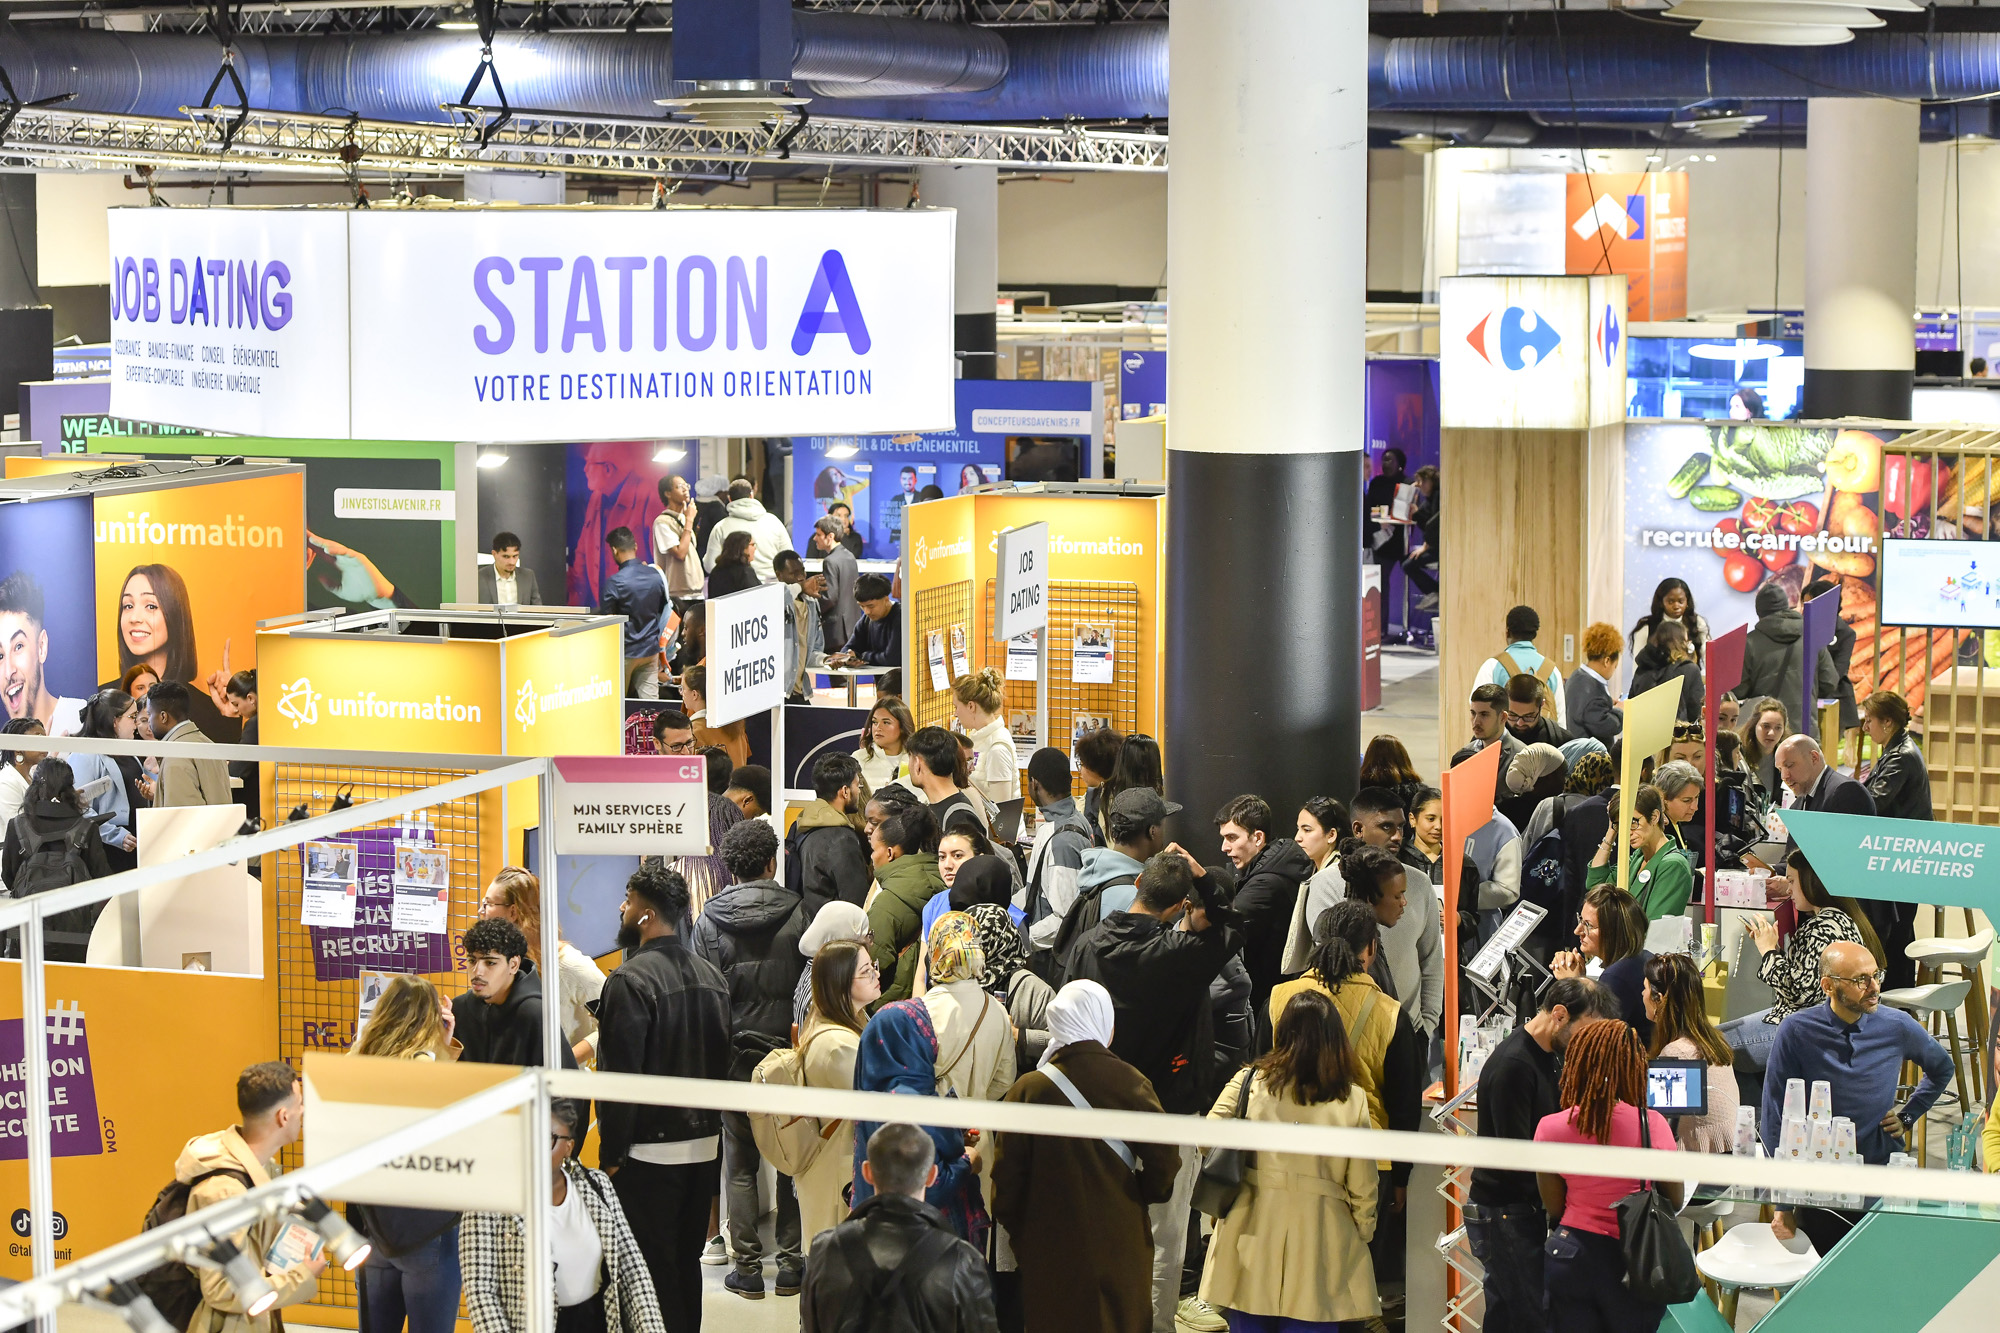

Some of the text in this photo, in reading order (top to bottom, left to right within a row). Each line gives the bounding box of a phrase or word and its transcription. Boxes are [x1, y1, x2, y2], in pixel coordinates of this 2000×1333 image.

[111, 256, 293, 332] JOB DATING
[472, 249, 872, 357] STATION A
[115, 339, 279, 369] ASSURANCE BANQUE-FINANCE CONSEIL ÉVÉNEMENTIEL
[126, 365, 184, 387] EXPERTISE-COMPTABLE
[192, 369, 223, 391] INGÉNIERIE
[227, 371, 260, 394] NUMÉRIQUE
[474, 368, 872, 402] VOTRE DESTINATION ORIENTATION
[978, 415, 1080, 428] CONCEPTEURSDAVENIRS.FR
[811, 436, 825, 450] DU
[871, 439, 878, 450] &
[881, 440, 892, 452] DE
[341, 497, 441, 511] JINVESTISLAVENIR.FR
[94, 512, 283, 549] uniformation
[1642, 527, 1890, 554] recrute.carrefour.
[929, 535, 972, 560] uniformation
[1047, 535, 1143, 556] iformation
[1018, 550, 1034, 575] JOB
[1011, 584, 1040, 614] DATING
[731, 614, 768, 649] INFOS
[724, 655, 775, 695] MÉTIERS
[540, 674, 612, 712] uniformation
[328, 691, 481, 723] uniformation
[679, 765, 700, 779] C5
[573, 803, 686, 818] MJN SERVICES /
[578, 820, 683, 834] FAMILY SPHÈRE
[1859, 835, 1985, 859] ALTERNANCE
[1867, 856, 1975, 878] ET MÉTIERS
[321, 932, 428, 959] RECRUTE
[303, 1021, 356, 1048] REJ
[103, 1116, 118, 1153] .COM
